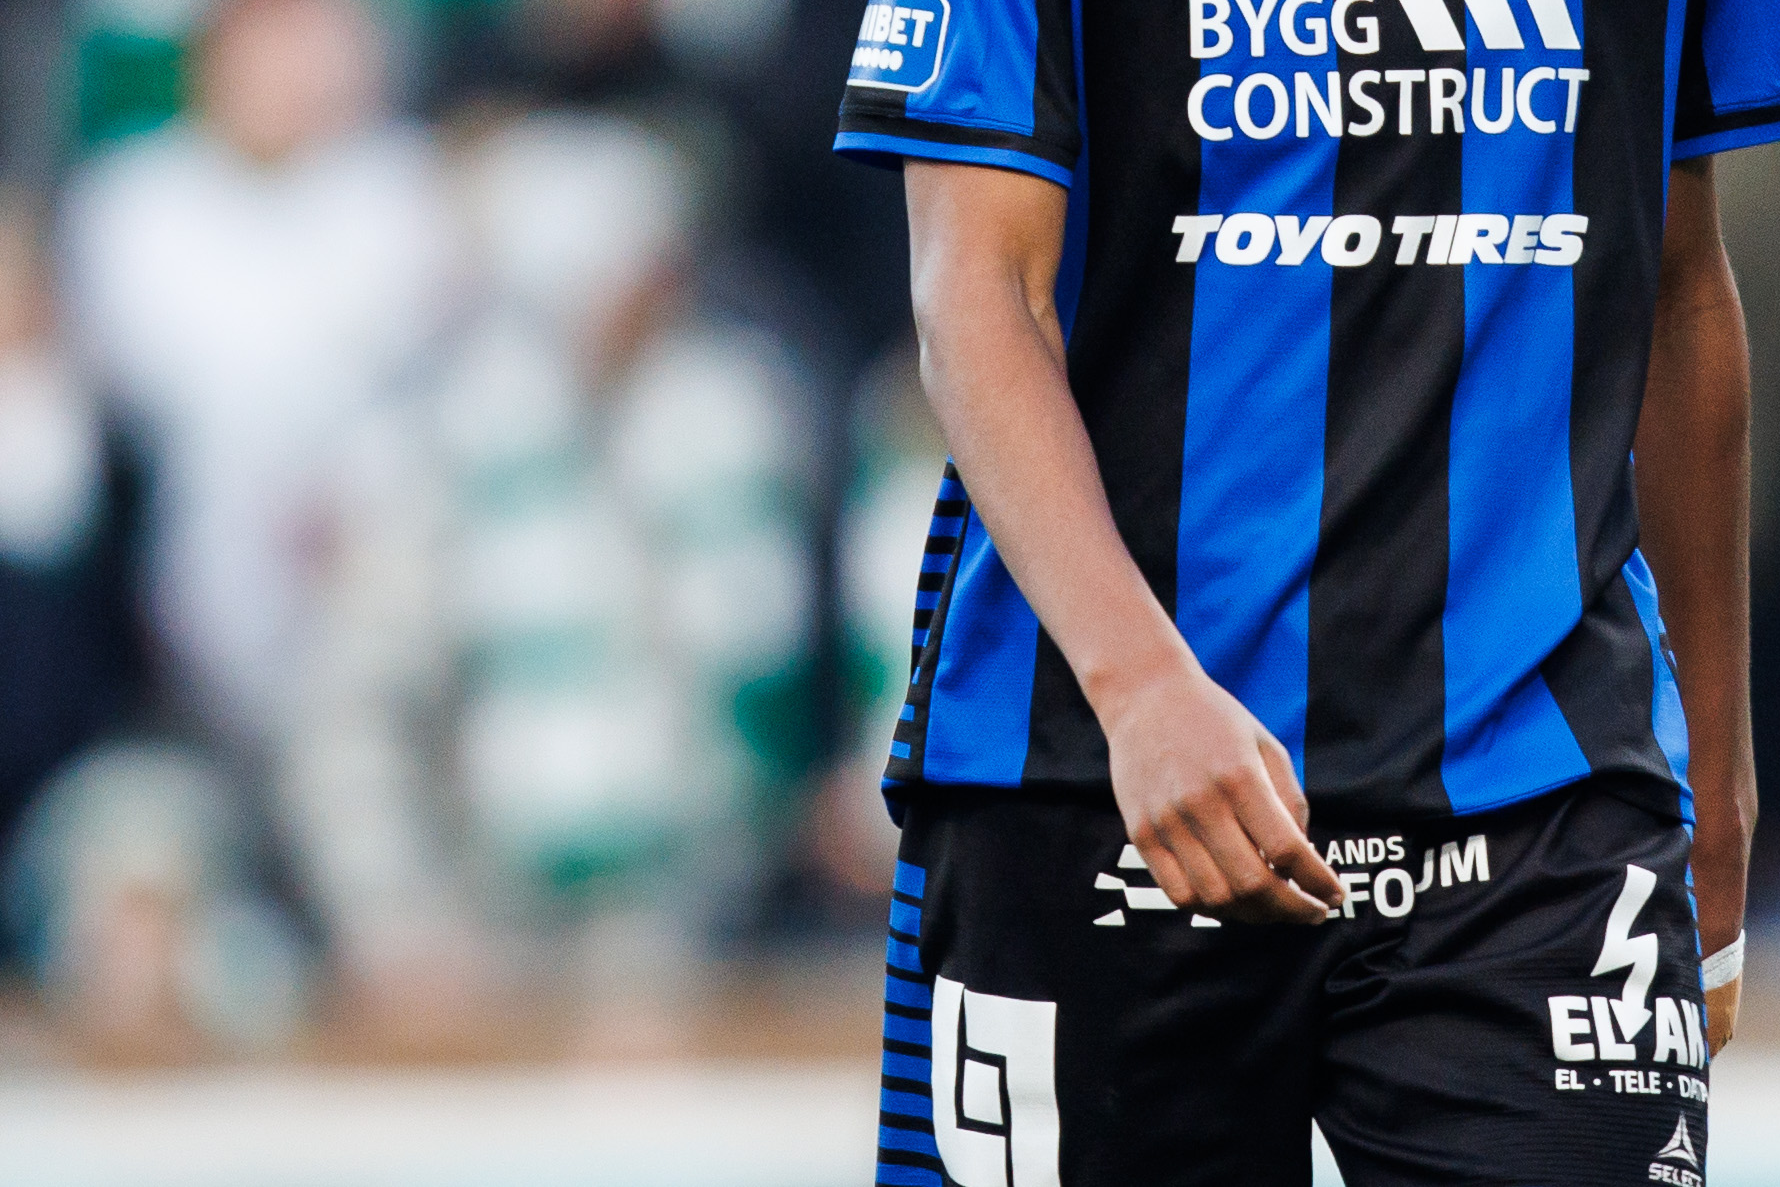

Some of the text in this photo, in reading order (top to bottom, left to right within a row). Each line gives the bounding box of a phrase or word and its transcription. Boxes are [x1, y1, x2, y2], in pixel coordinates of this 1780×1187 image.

[1187, 66, 1591, 142] CONSTRUCT
[1171, 212, 1589, 267] TOYO TIRES
[1325, 835, 1405, 866] ANDS
[1555, 1069, 1585, 1091] EL
[1609, 1070, 1661, 1095] TELE
